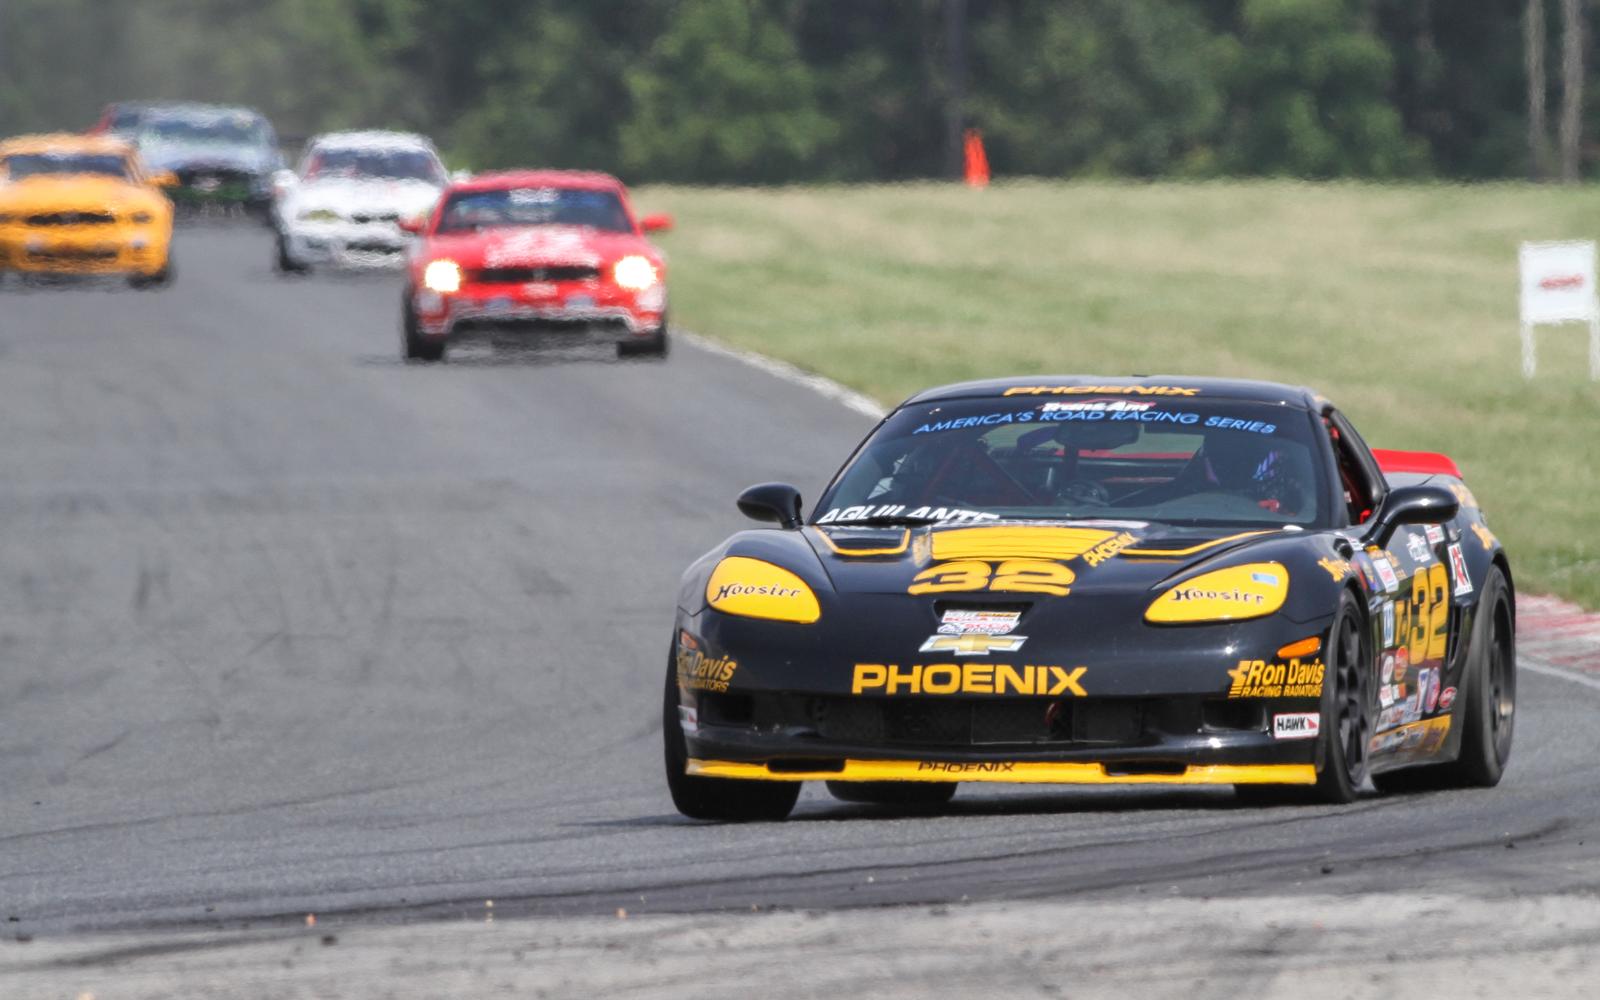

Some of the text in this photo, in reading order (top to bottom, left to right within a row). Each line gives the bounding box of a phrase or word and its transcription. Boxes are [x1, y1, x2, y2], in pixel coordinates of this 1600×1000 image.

[1003, 385, 1199, 397] PHOENIX
[913, 411, 1277, 434] AMERICA'S ROAD RACING SERIES
[907, 560, 1076, 596] 32
[1408, 563, 1450, 665] 32
[694, 652, 737, 681] Davis
[1247, 658, 1325, 686] Ron Davis
[852, 664, 1089, 697] PHOENIX
[1241, 685, 1324, 698] RACING RADIATORS
[1277, 718, 1307, 731] HAWK
[918, 761, 1016, 773] PHOENIX
